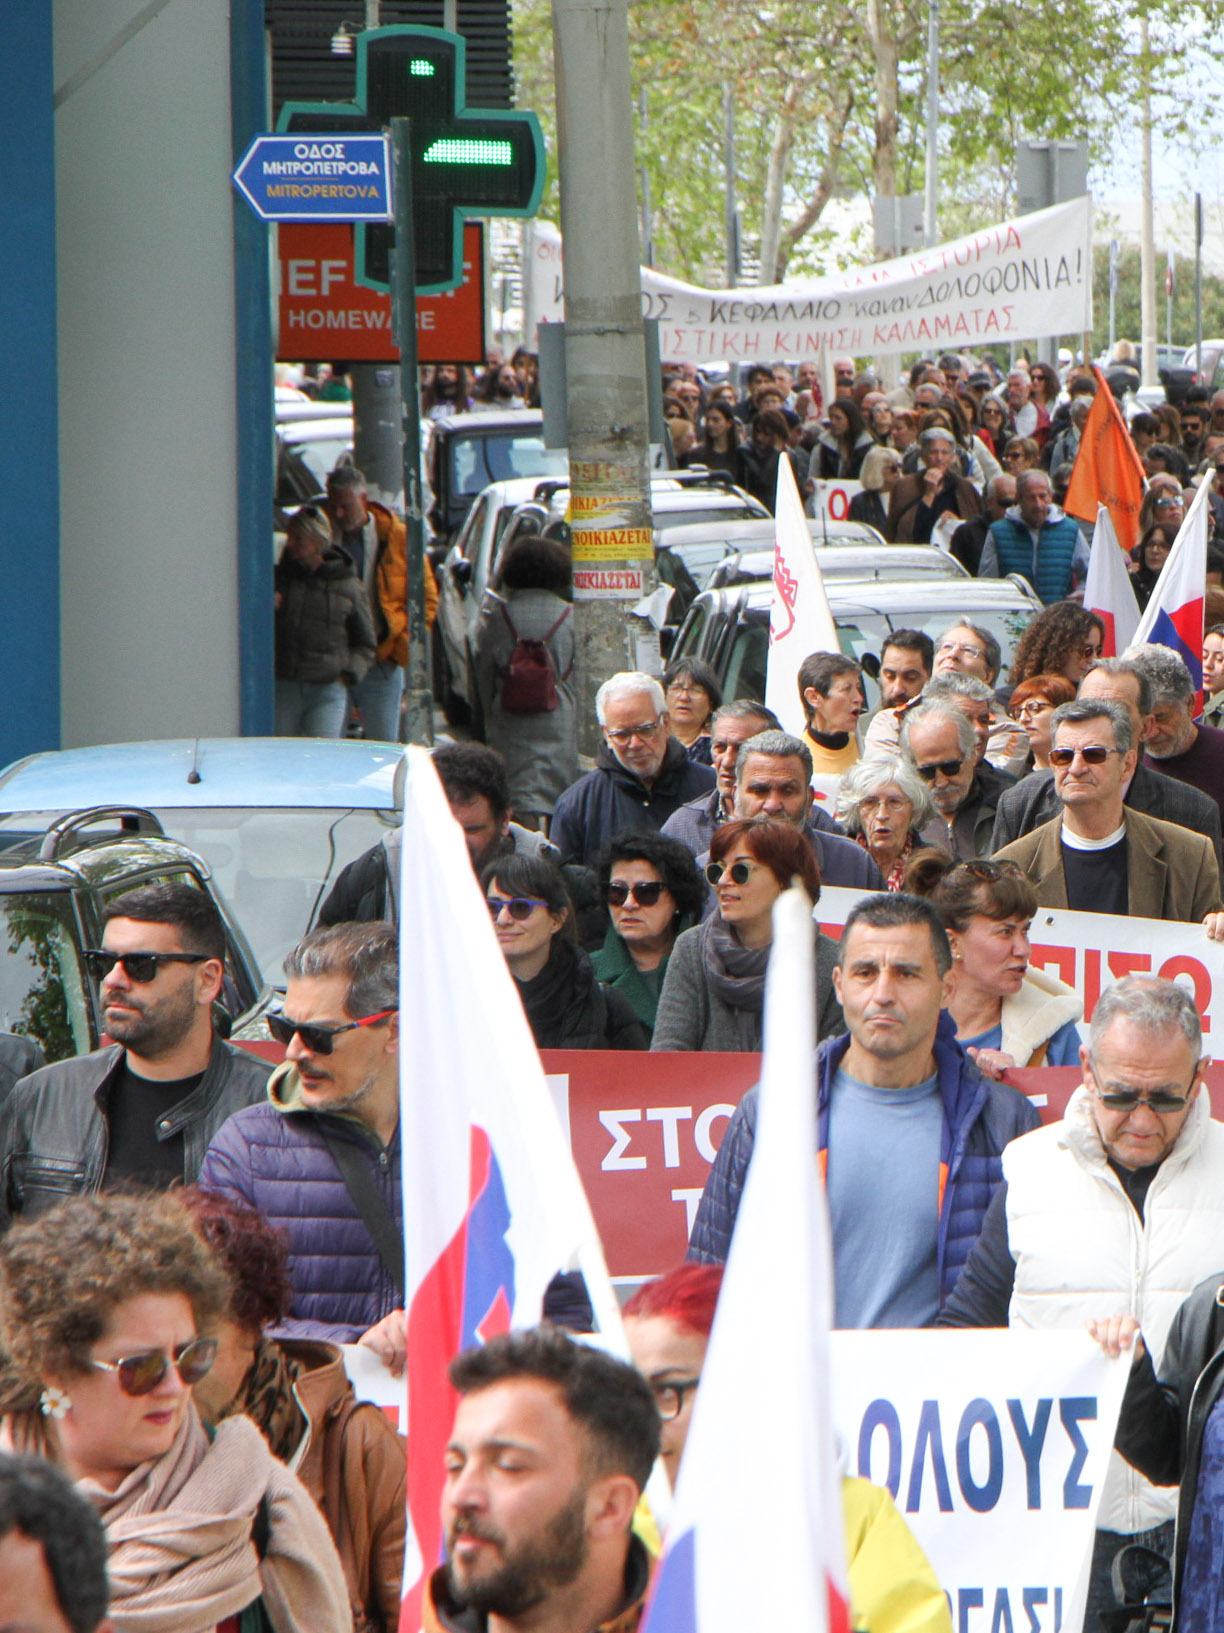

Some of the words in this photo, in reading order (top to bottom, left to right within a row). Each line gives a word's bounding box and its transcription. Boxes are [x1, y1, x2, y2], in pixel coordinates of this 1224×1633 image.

[294, 144, 345, 159] ΟΔΟΣ
[262, 161, 379, 175] ΜΗΤΡΟΠΕΤΡΟΒΑ
[266, 184, 379, 198] MITROPERTOVA
[279, 259, 347, 296] EF
[289, 309, 436, 330] HOMEWE
[709, 299, 841, 324] ΚΕΦΑΛΑΙΟ
[662, 328, 761, 355] ΙΣΤΙΚΗ
[873, 305, 1019, 344] ΚΑΛΑΜΑΤΑΣ
[572, 529, 651, 545] ΝΟΙΚΙΑΖΕΤΑΙ
[598, 1103, 738, 1172] ΣΤΟ
